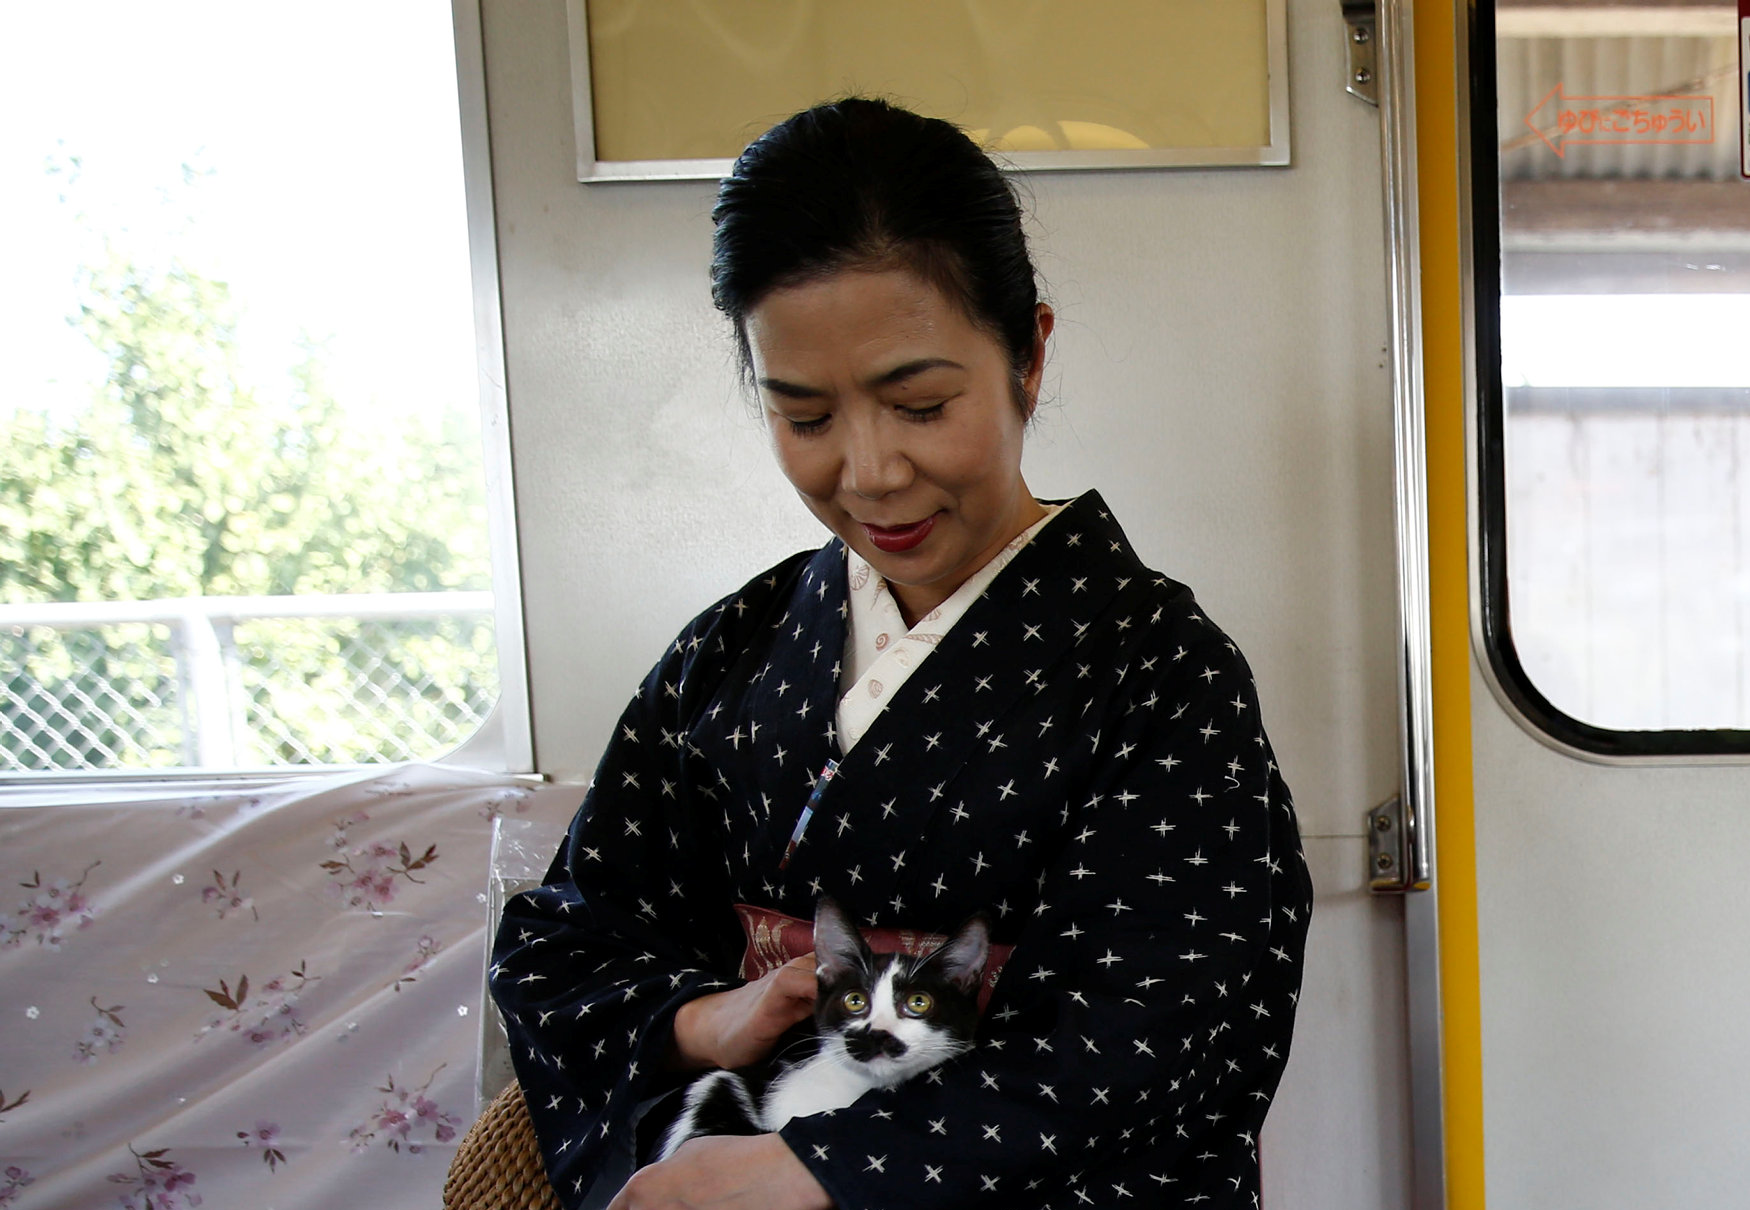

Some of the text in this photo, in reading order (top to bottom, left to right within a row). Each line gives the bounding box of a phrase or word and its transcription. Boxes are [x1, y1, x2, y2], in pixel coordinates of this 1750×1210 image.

[1557, 108, 1706, 134] ゆびにごちゅうい
